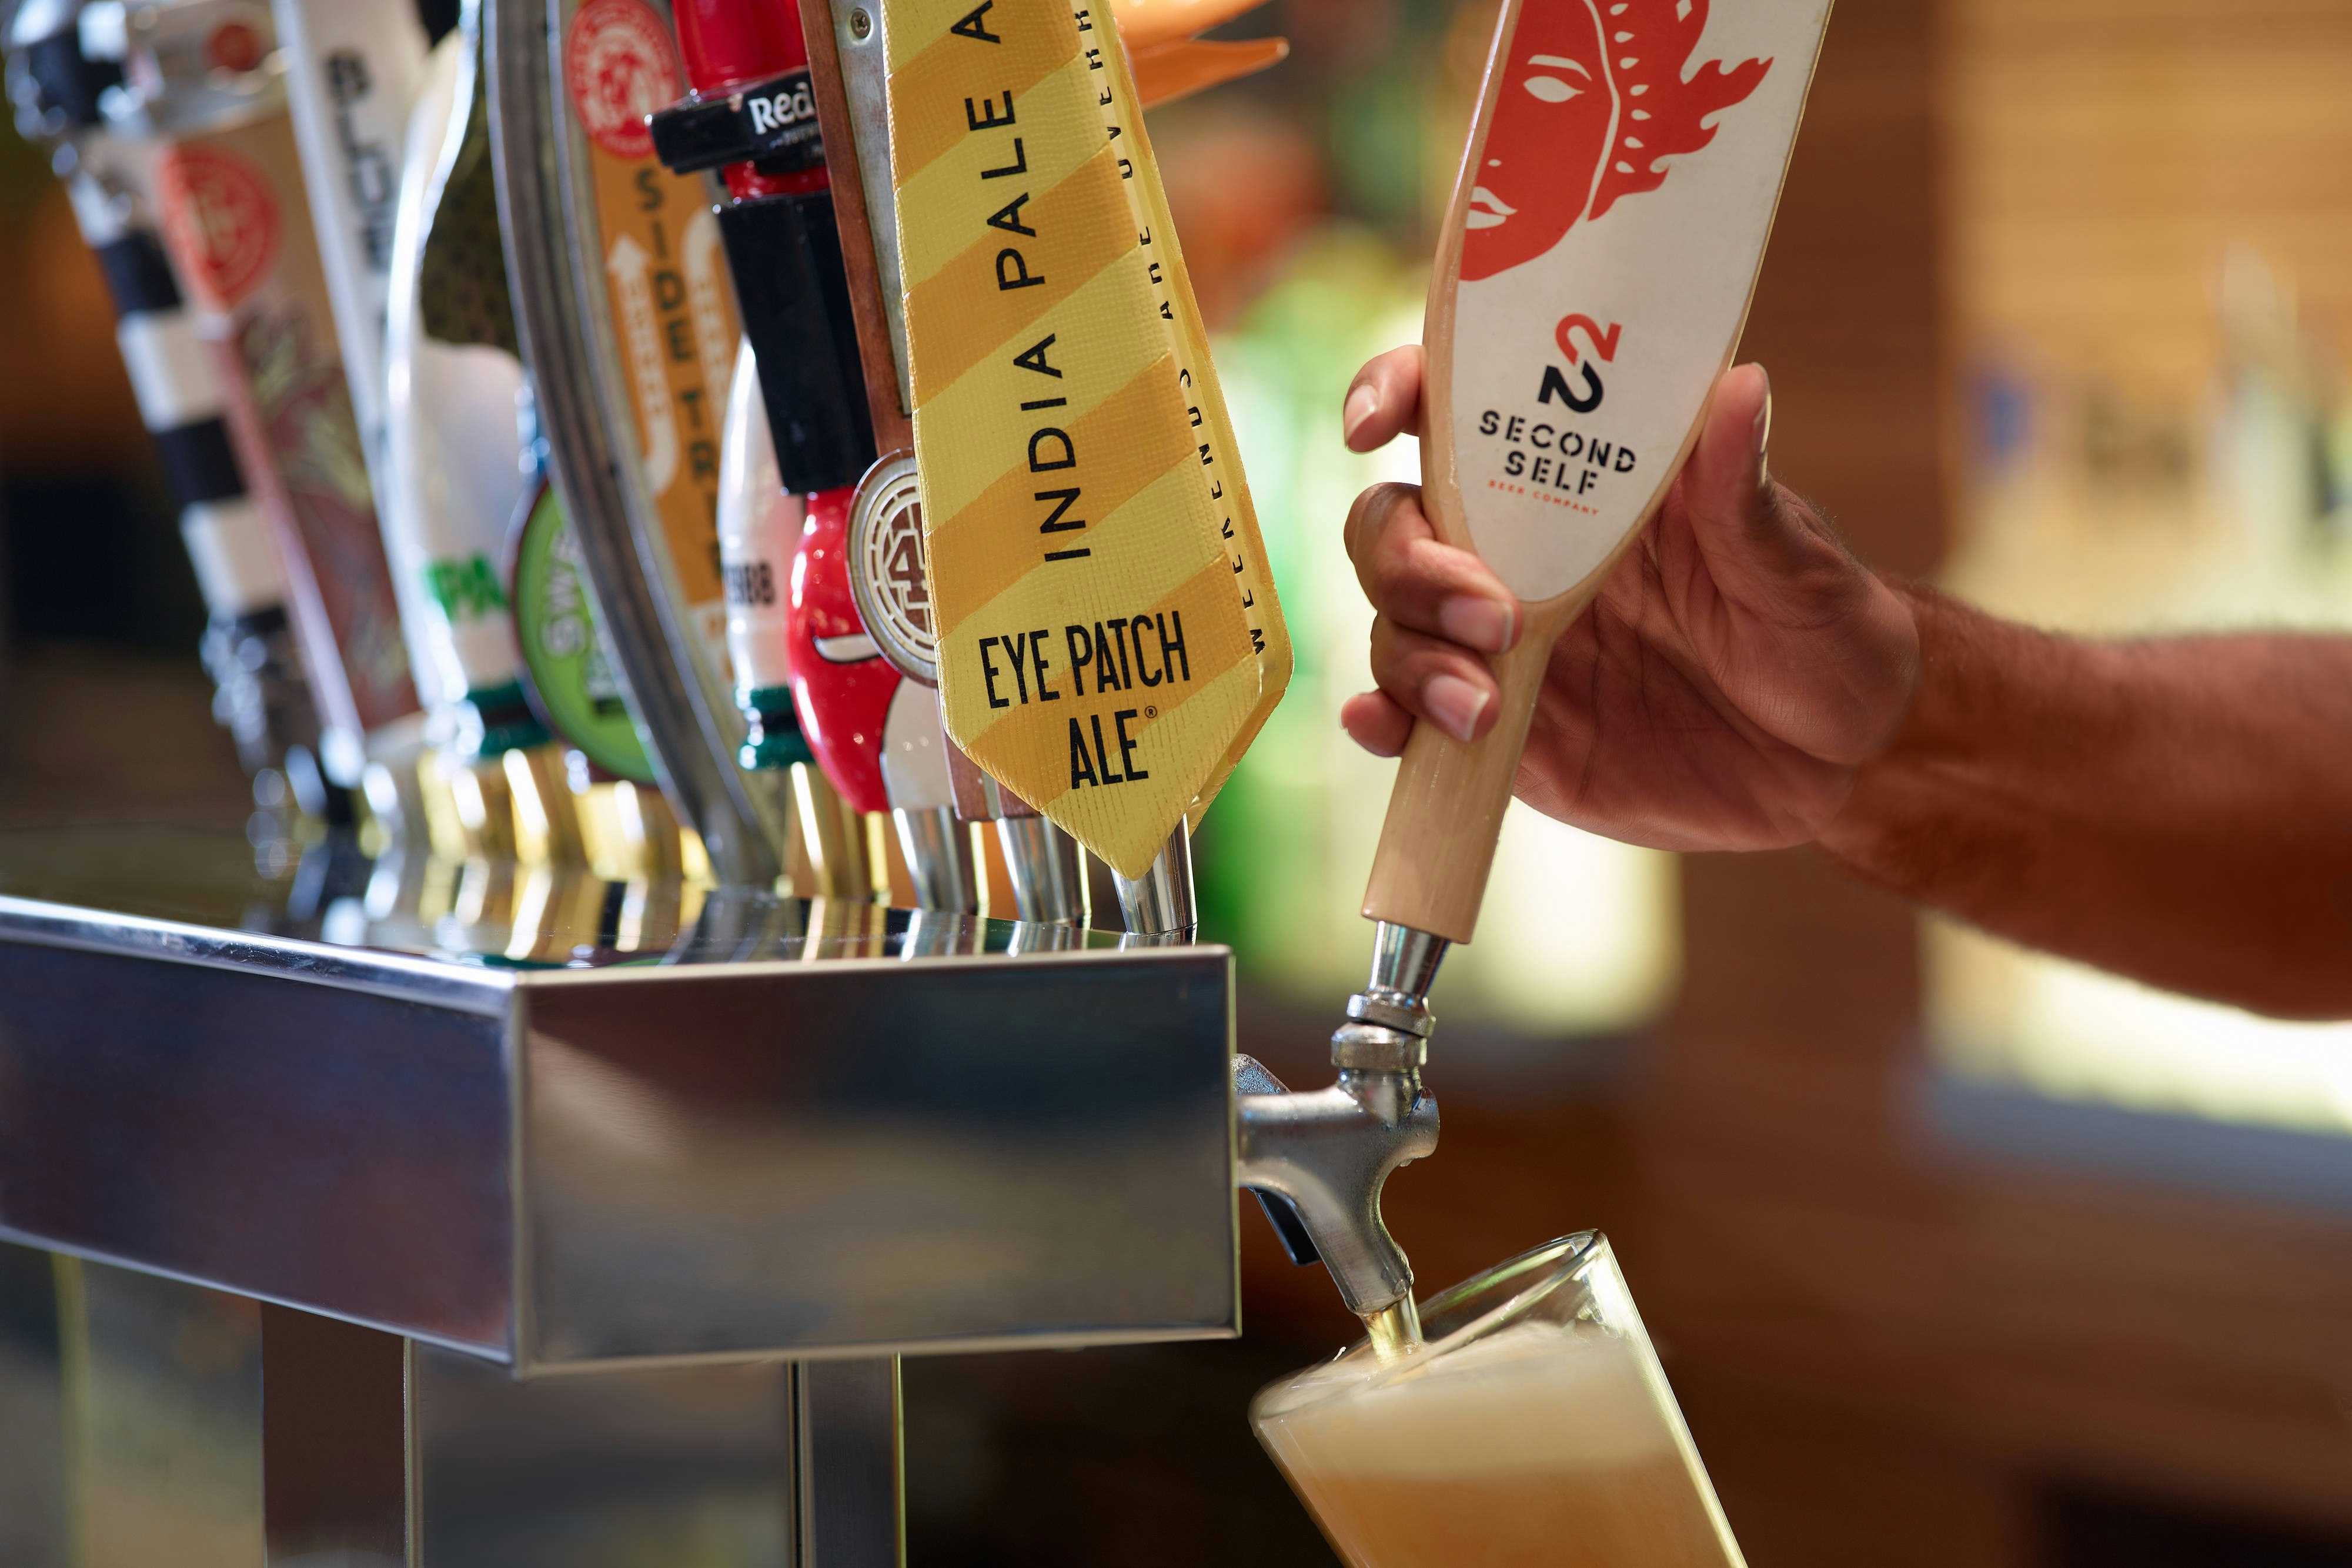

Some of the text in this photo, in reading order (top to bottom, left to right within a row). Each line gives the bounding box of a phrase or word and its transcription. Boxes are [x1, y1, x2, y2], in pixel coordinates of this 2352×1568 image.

[747, 82, 816, 136] Red
[964, 90, 1045, 291] PALE
[635, 168, 694, 361] SIDE
[1013, 333, 1092, 563] INDIA
[1479, 410, 1637, 473] SECOND
[1504, 450, 1599, 496] SELF
[1488, 479, 1600, 516] BEER COMPANY
[978, 610, 1191, 709] EYE PATCH
